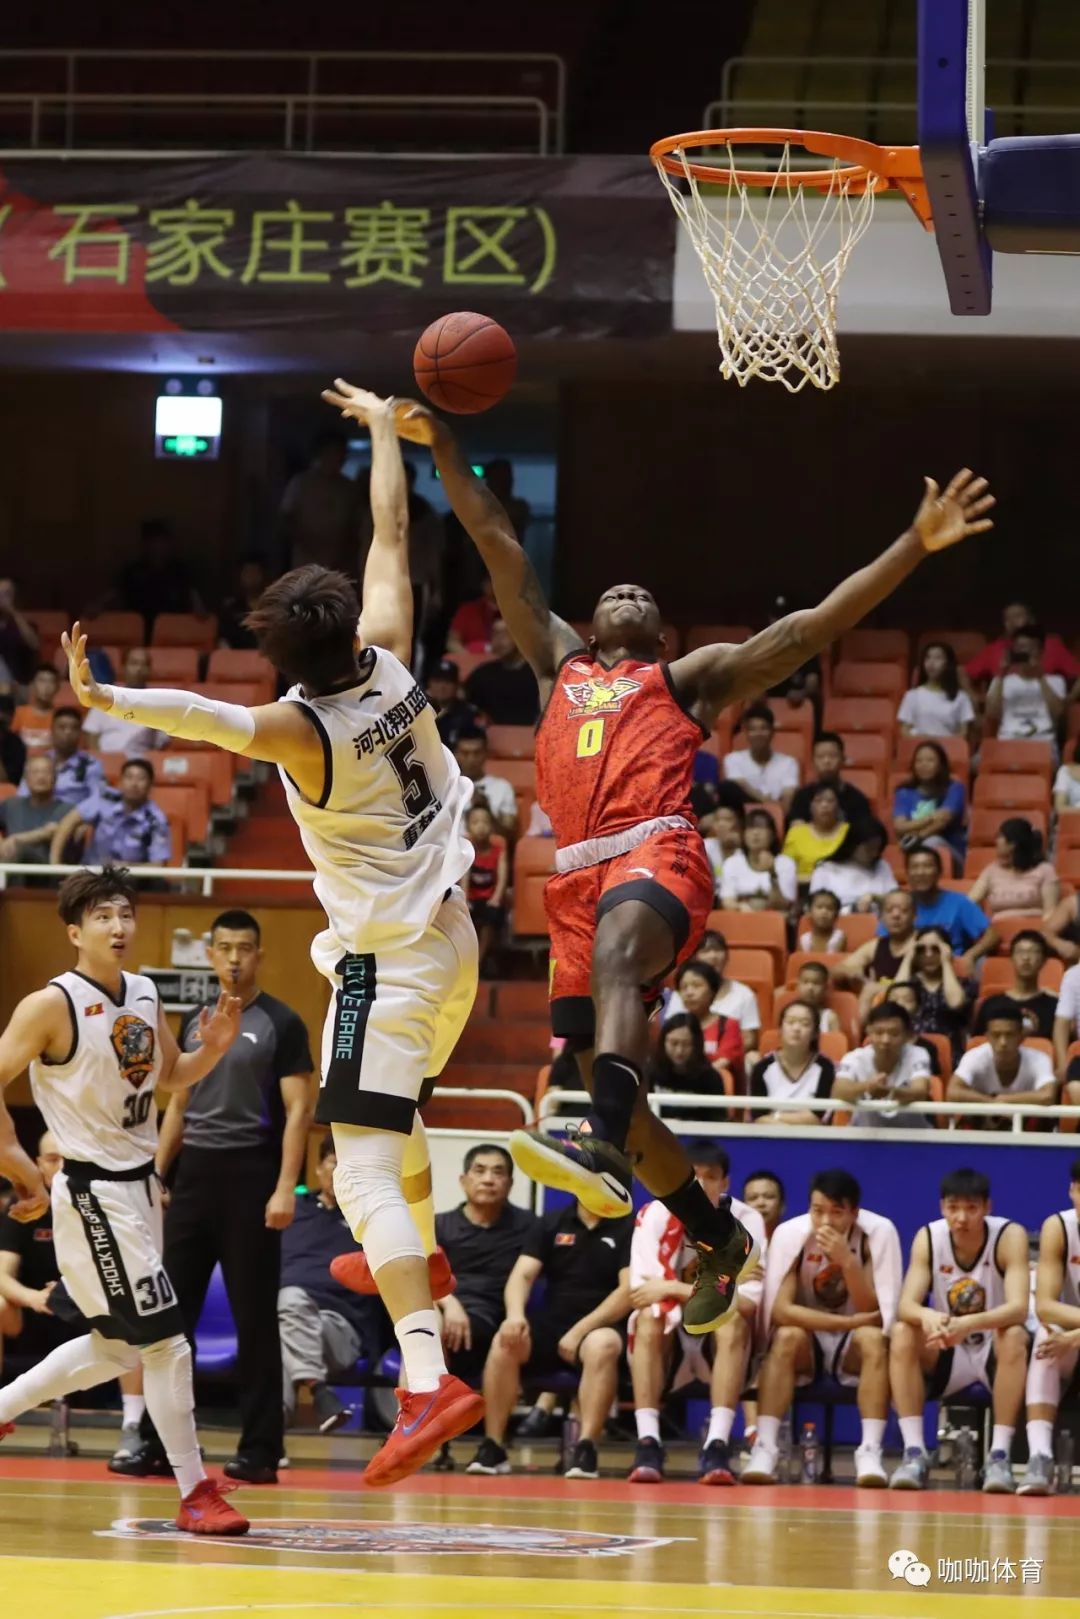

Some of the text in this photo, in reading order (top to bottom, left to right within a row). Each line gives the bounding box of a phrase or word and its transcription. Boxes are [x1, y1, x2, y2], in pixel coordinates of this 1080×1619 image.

[576, 718, 605, 758] 0
[384, 729, 438, 819] 5
[335, 1010, 360, 1060] GAME
[122, 1090, 154, 1130] 30
[90, 1225, 111, 1252] THE
[97, 1251, 126, 1297] SHOCK
[136, 1267, 177, 1313] 30
